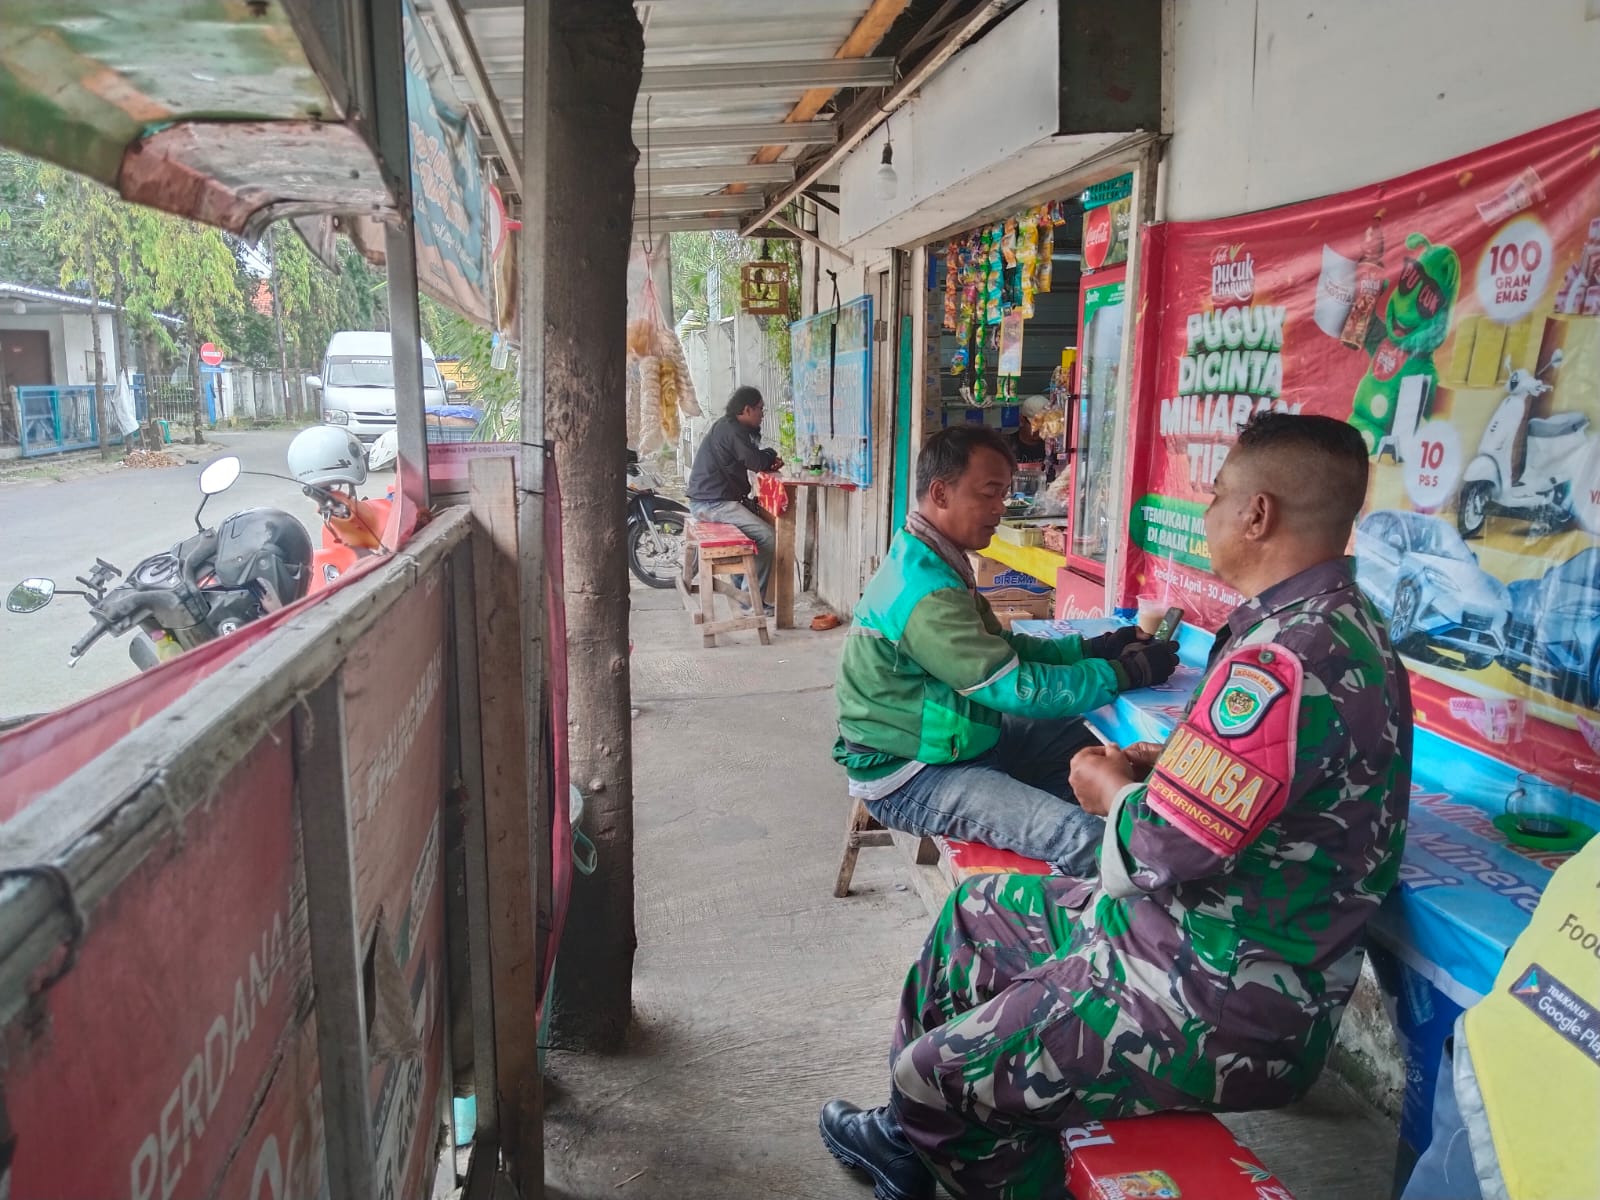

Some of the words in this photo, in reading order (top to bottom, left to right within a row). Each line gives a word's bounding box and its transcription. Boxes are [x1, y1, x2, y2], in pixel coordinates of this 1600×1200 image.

[1490, 240, 1542, 276] 100
[1495, 274, 1531, 289] GRAM
[1495, 289, 1528, 304] EMAS
[1186, 304, 1287, 353] PUCUK
[1178, 350, 1283, 396] DICINTA
[1420, 441, 1444, 469] 10
[1418, 475, 1431, 487] PS
[1432, 475, 1439, 487] 5
[1141, 506, 1189, 531] TEMUKAN
[1147, 527, 1159, 542] DI
[1158, 529, 1188, 552] BALIK
[1184, 576, 1202, 593] April
[1207, 583, 1218, 599] 30
[1219, 589, 1236, 606] Juni
[1547, 985, 1580, 1014] TEMUKAN
[1538, 996, 1582, 1036] Google
